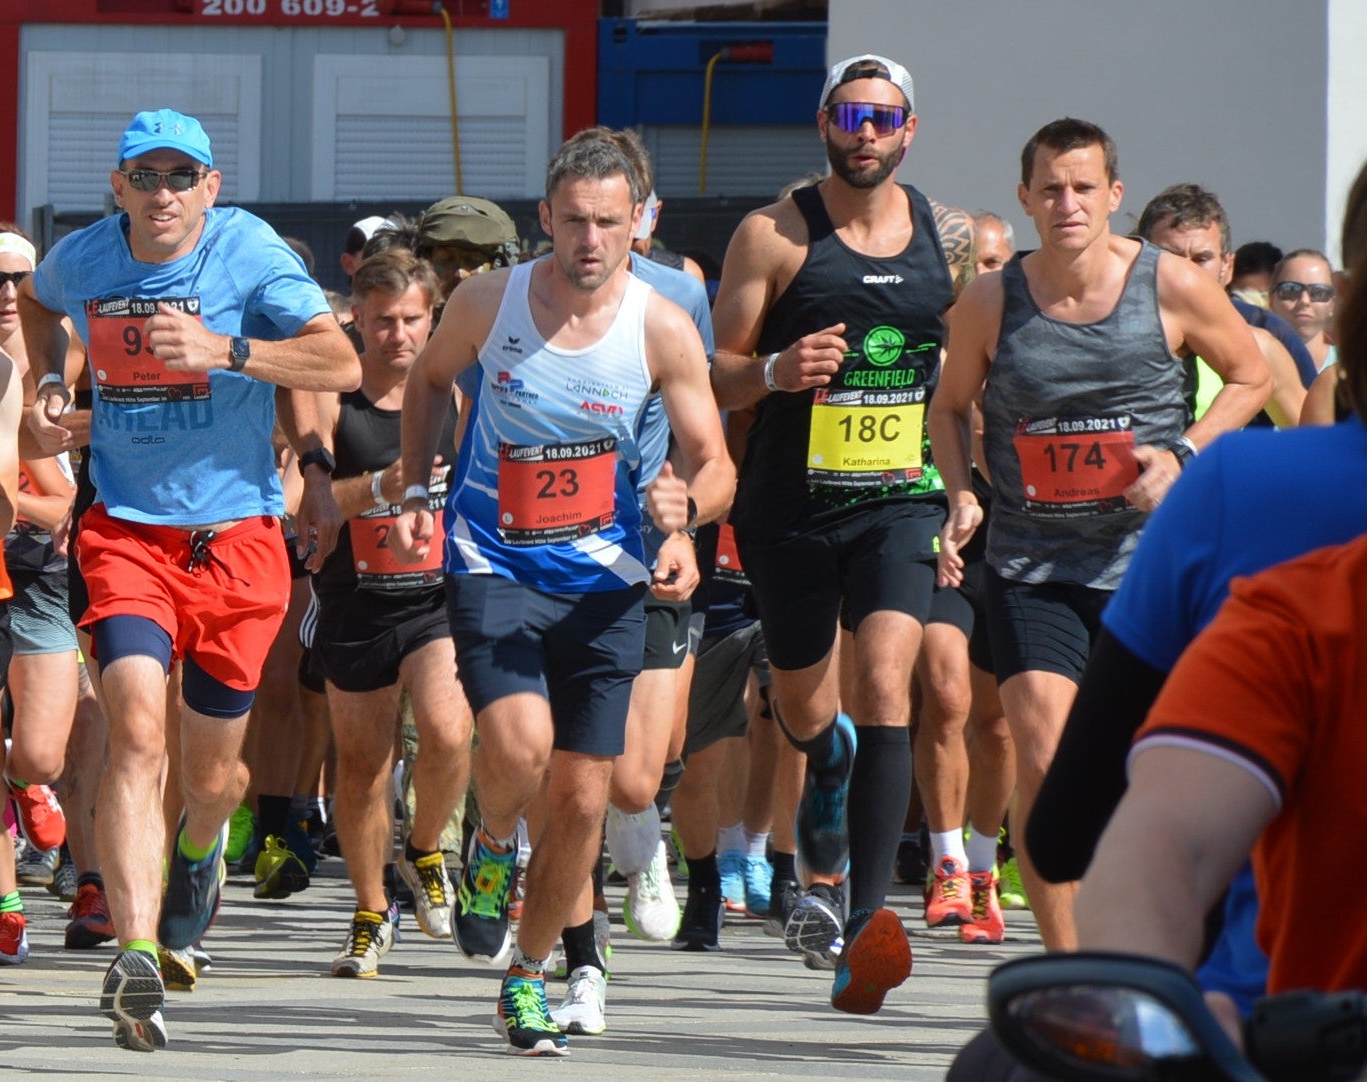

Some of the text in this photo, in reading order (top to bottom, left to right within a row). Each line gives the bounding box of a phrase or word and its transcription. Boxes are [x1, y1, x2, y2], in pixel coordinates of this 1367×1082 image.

[863, 275, 895, 284] CRAFT
[123, 326, 154, 356] 9
[133, 372, 161, 381] Peter
[844, 369, 915, 387] GREENFIELD
[863, 391, 914, 404] 18.09.2021
[838, 414, 901, 442] 18C
[1058, 419, 1115, 432] 18.09.2021
[546, 443, 601, 459] 18.09.2021
[1043, 441, 1106, 473] 174
[842, 457, 891, 466] Katharina
[536, 469, 580, 499] 23
[1054, 488, 1099, 497] Andreas
[536, 511, 582, 524] Joachim
